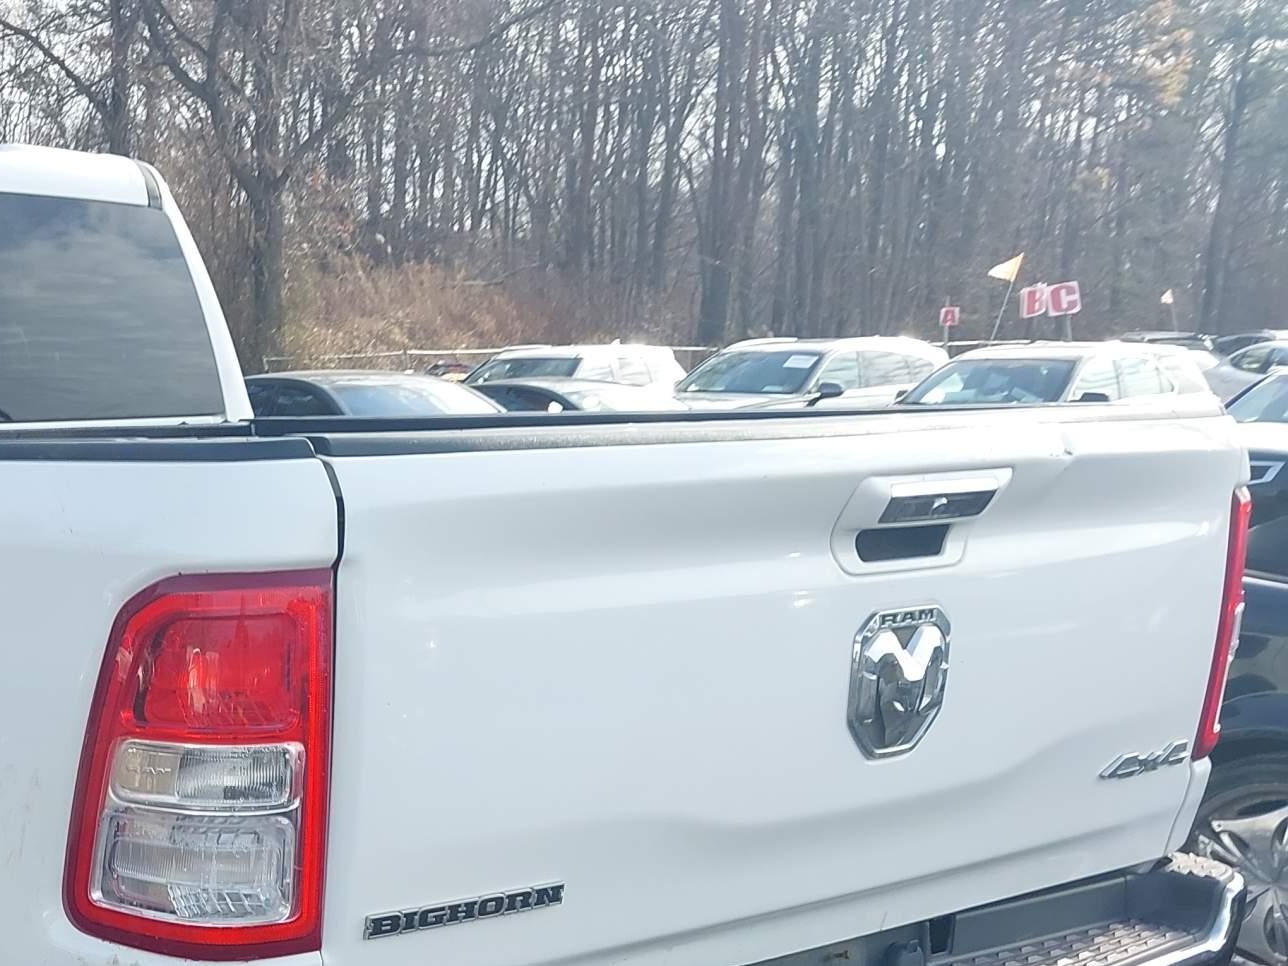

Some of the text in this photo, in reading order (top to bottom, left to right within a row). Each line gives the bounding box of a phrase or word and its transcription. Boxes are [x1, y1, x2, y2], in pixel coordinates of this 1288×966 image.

[1050, 285, 1076, 312] C
[944, 309, 956, 324] A
[880, 608, 936, 627] RAM
[364, 882, 565, 939] BIGHORN
